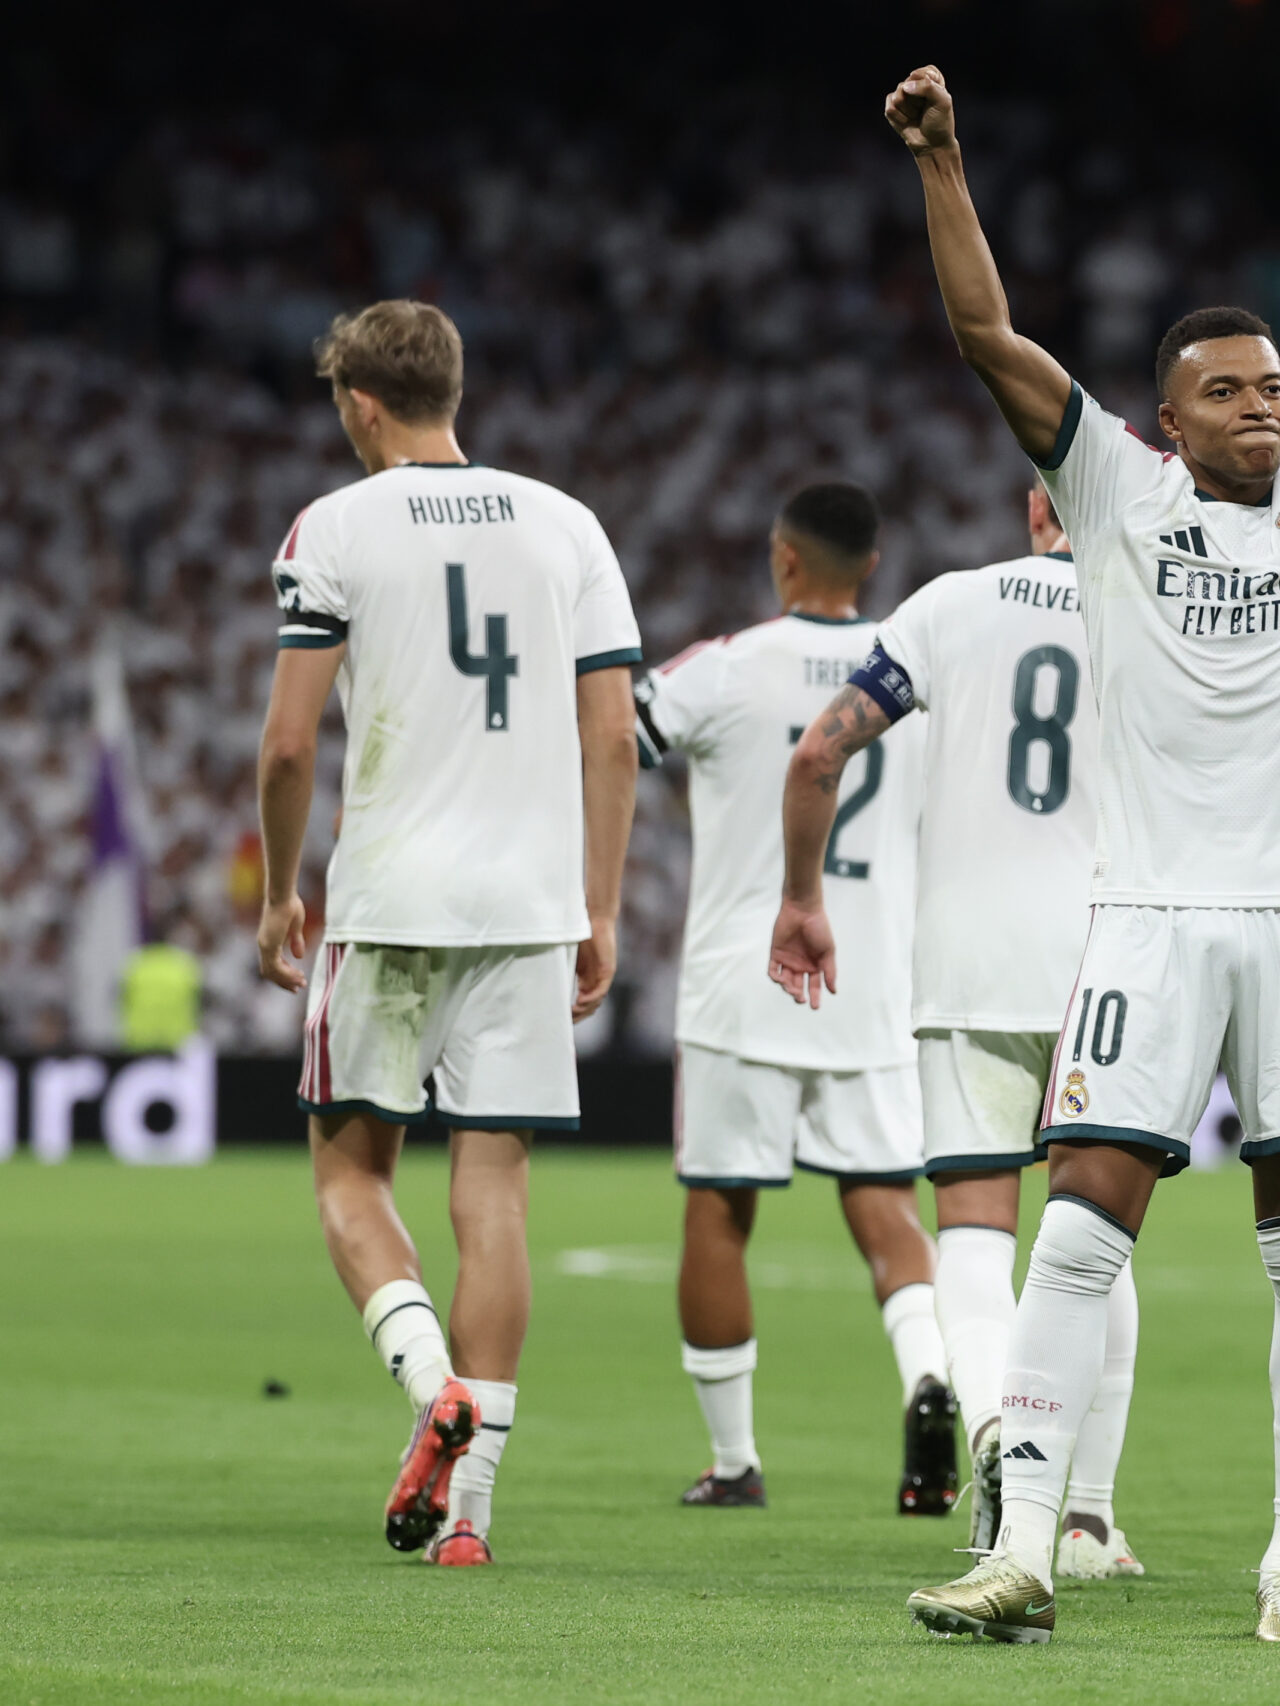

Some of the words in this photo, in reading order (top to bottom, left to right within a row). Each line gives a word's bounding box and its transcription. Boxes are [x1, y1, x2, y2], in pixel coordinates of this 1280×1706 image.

[408, 494, 515, 525] HUIJSEN
[999, 577, 1081, 612] VALVE
[1182, 605, 1222, 635] FLY
[445, 562, 518, 732] 4
[1007, 643, 1079, 816] 8
[788, 725, 885, 880] 2
[1072, 988, 1128, 1066] 10
[0, 1036, 216, 1166] rd
